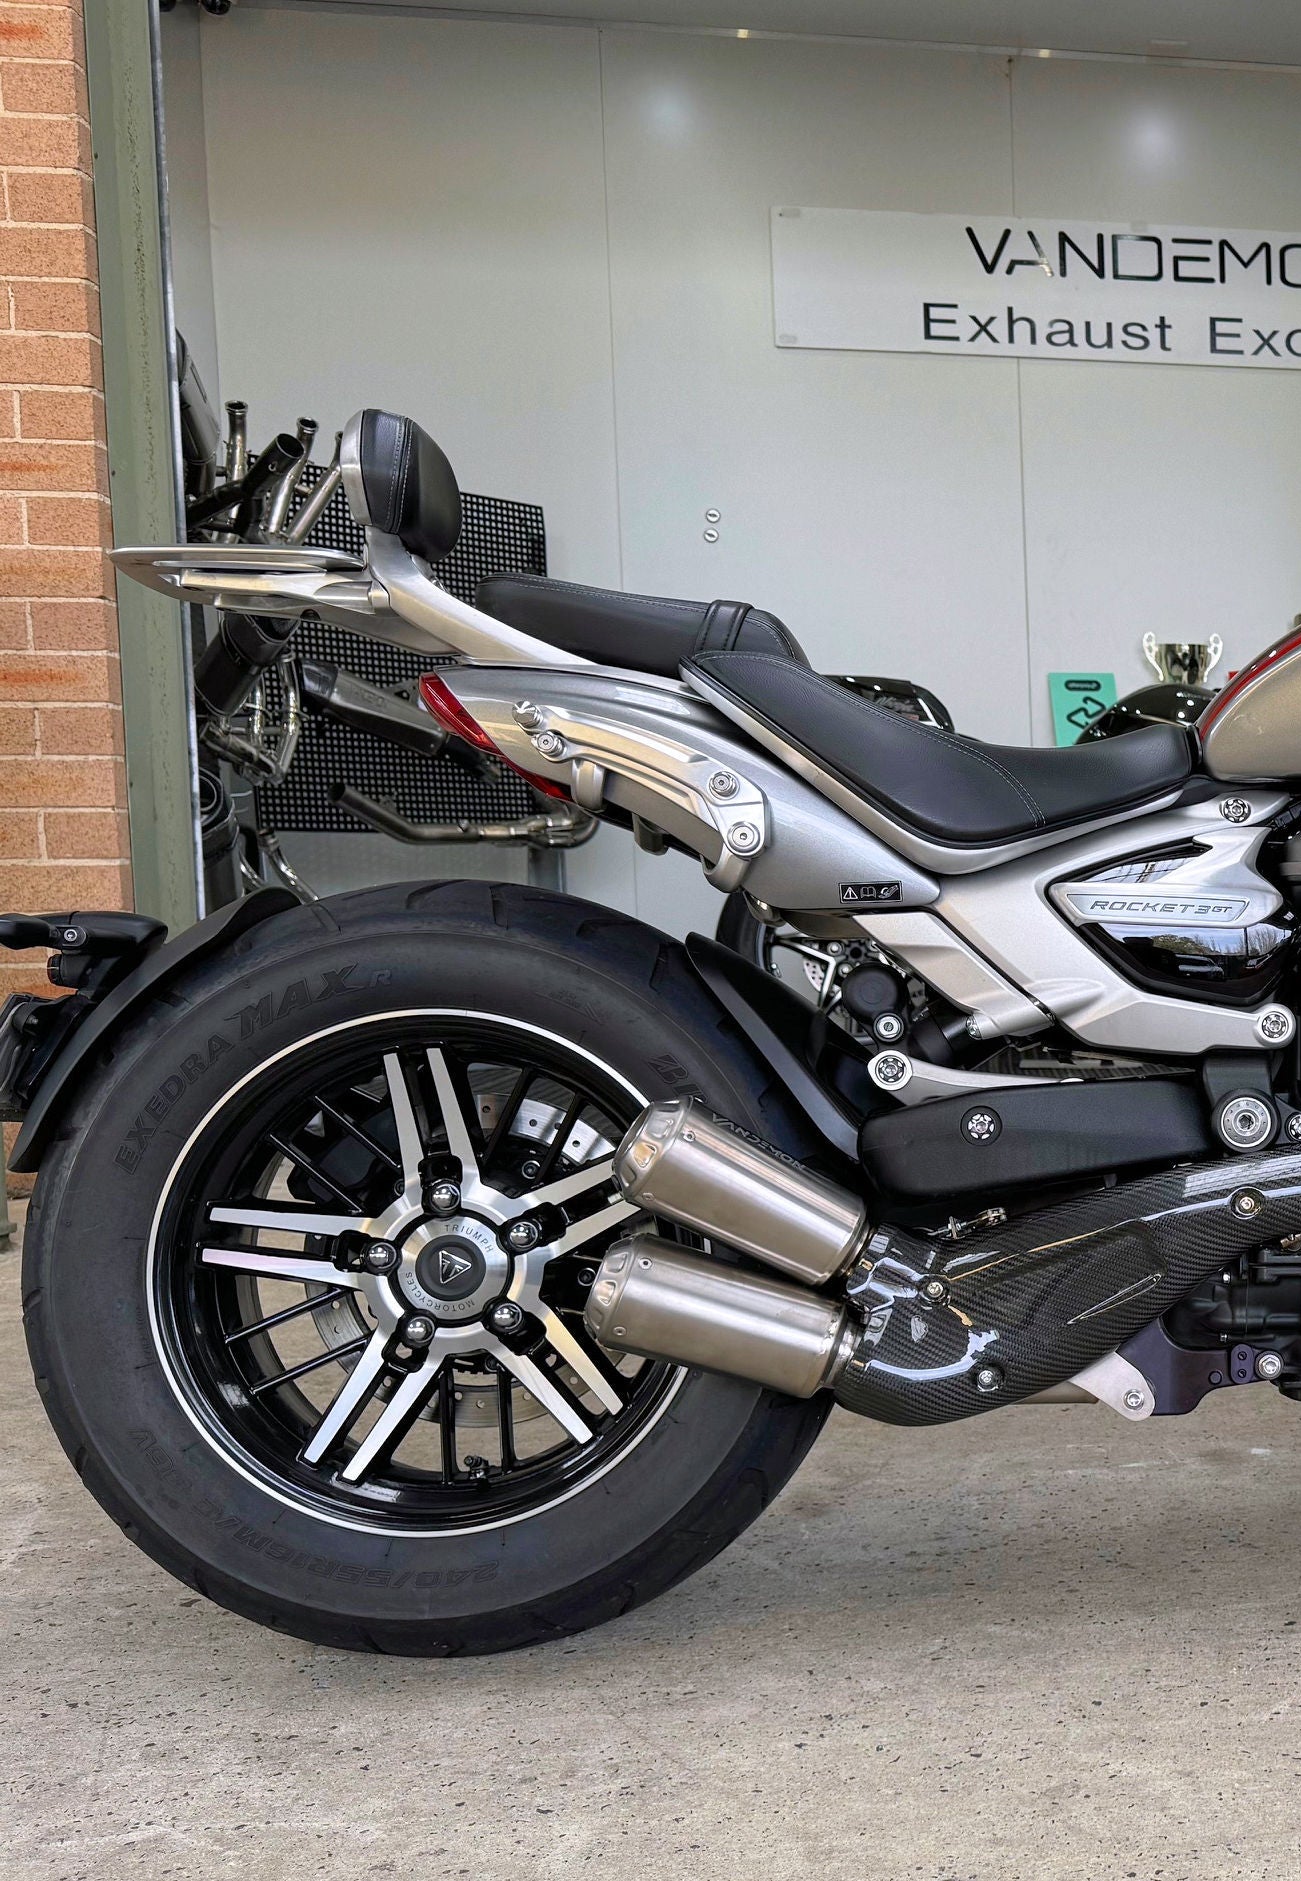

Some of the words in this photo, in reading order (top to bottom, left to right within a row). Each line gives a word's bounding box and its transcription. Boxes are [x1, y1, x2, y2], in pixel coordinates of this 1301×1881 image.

[922, 302, 1173, 353] Exhaust
[112, 1032, 236, 1176] EXEDRA
[223, 962, 367, 1040] MAX
[444, 1224, 494, 1253] TRIUMPH
[405, 1271, 476, 1312] MOTORCYCLES
